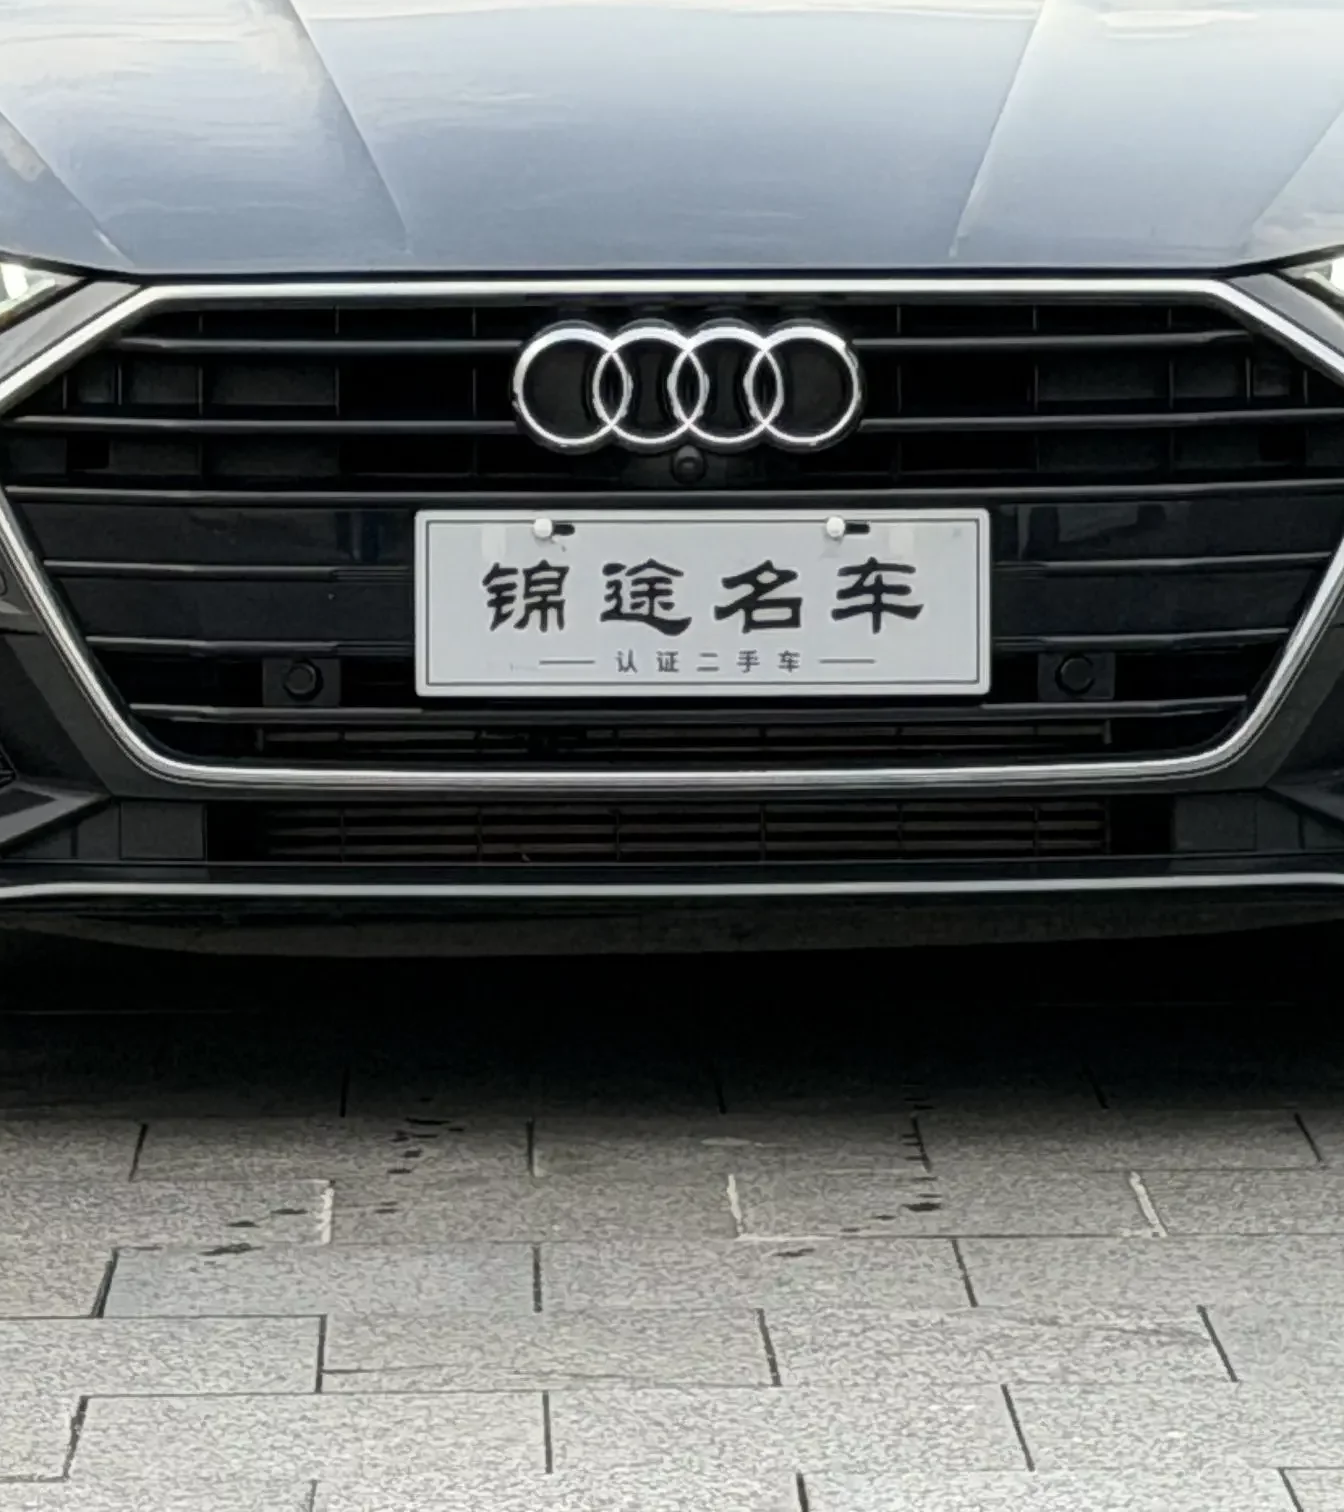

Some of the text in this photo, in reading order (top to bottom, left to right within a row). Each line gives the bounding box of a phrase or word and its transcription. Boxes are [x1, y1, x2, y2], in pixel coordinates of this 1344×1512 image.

[481, 555, 925, 635] 锦途名车
[615, 649, 801, 674] 认证二手车
